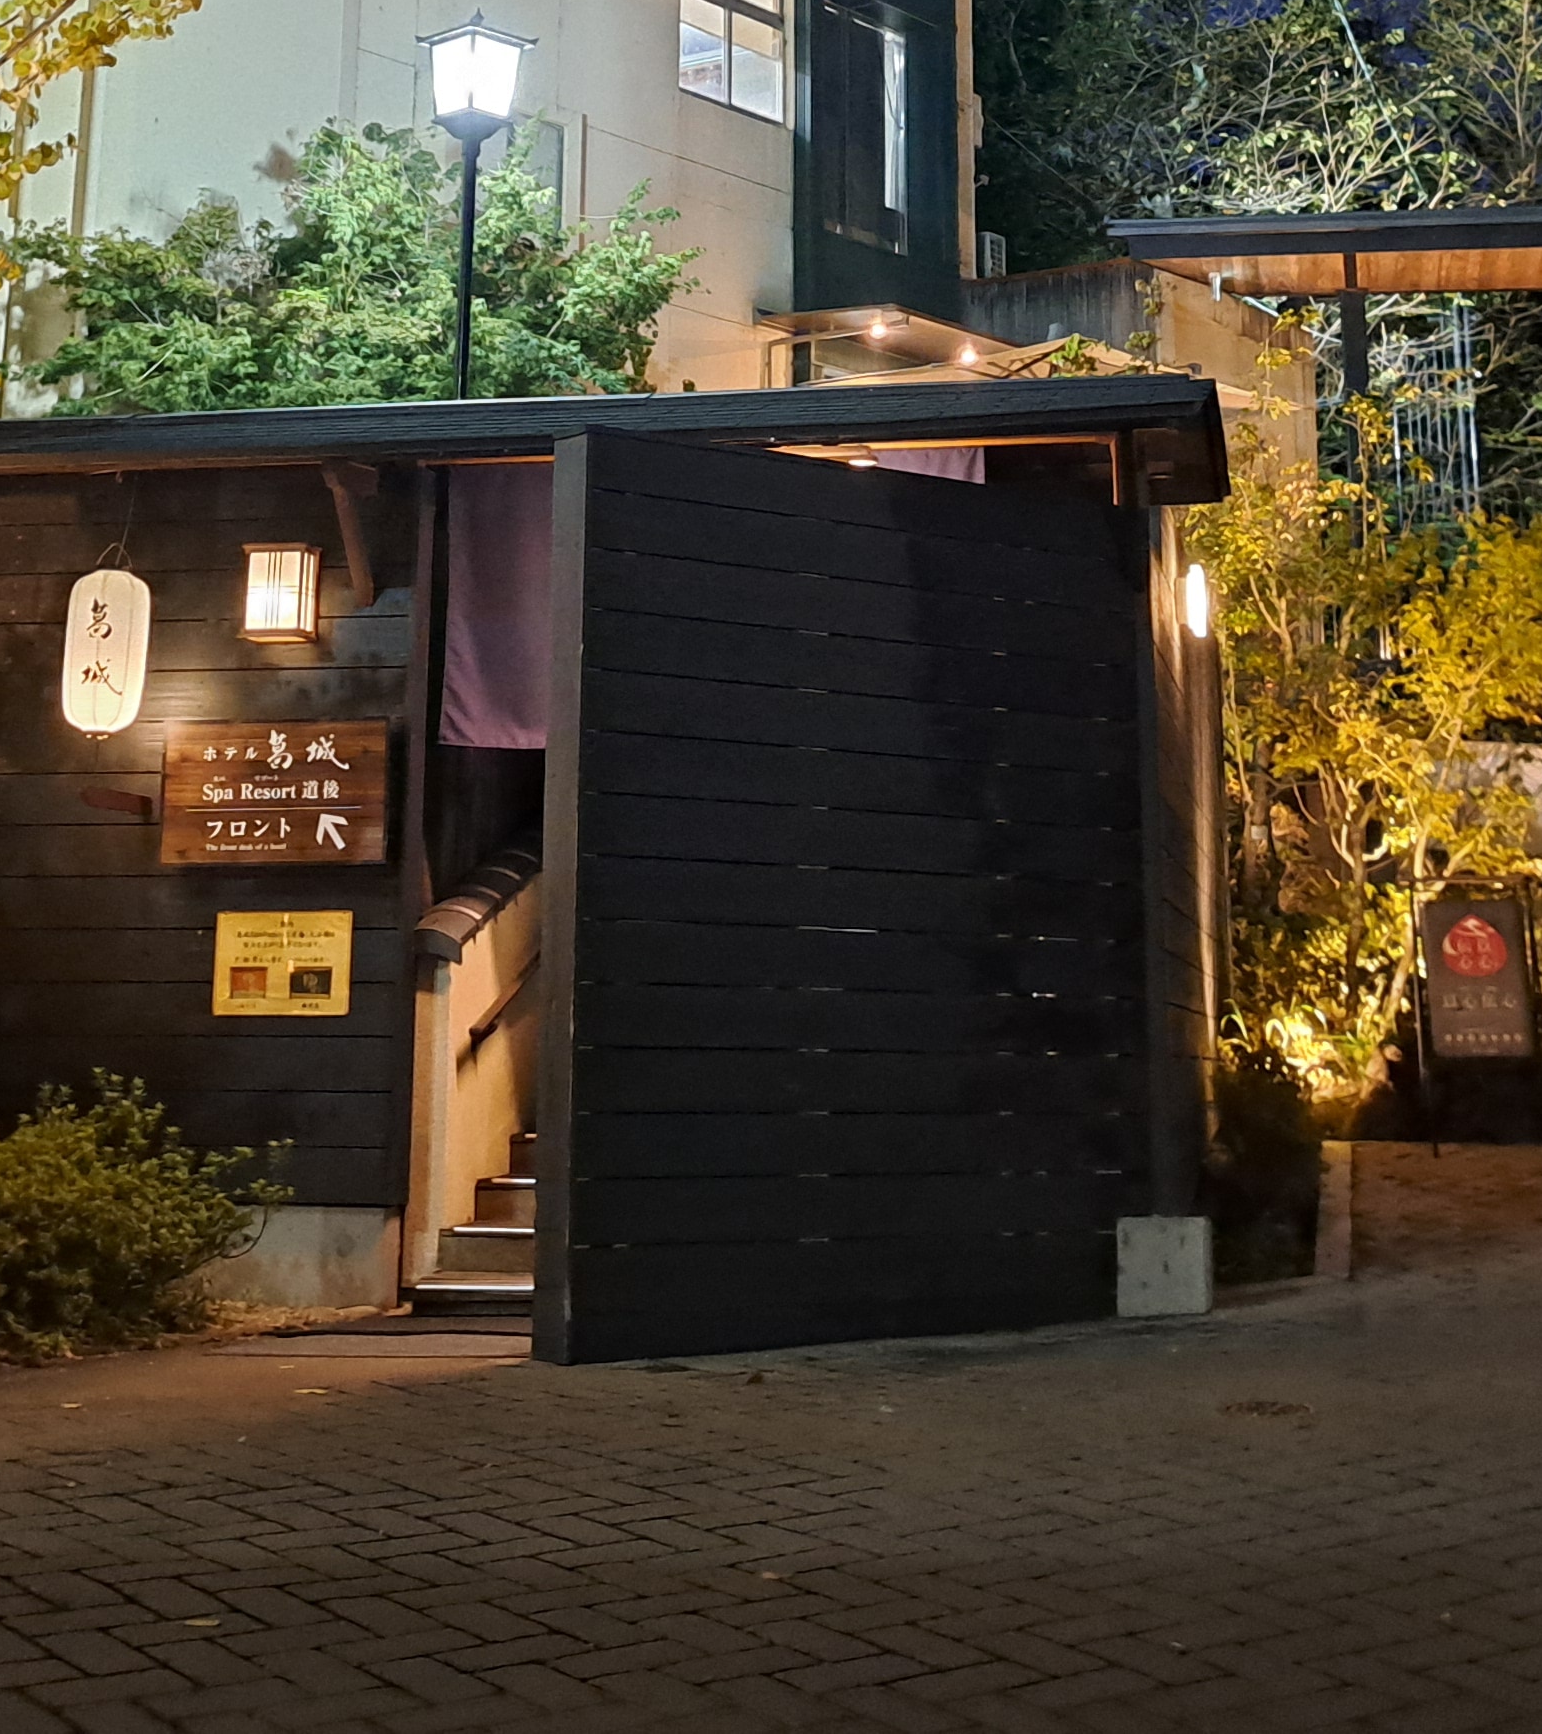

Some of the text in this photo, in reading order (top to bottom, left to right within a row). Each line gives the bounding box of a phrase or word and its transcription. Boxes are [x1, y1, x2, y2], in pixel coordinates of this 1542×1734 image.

[202, 779, 340, 803] Spa Resort 道後
[206, 817, 292, 839] フロント
